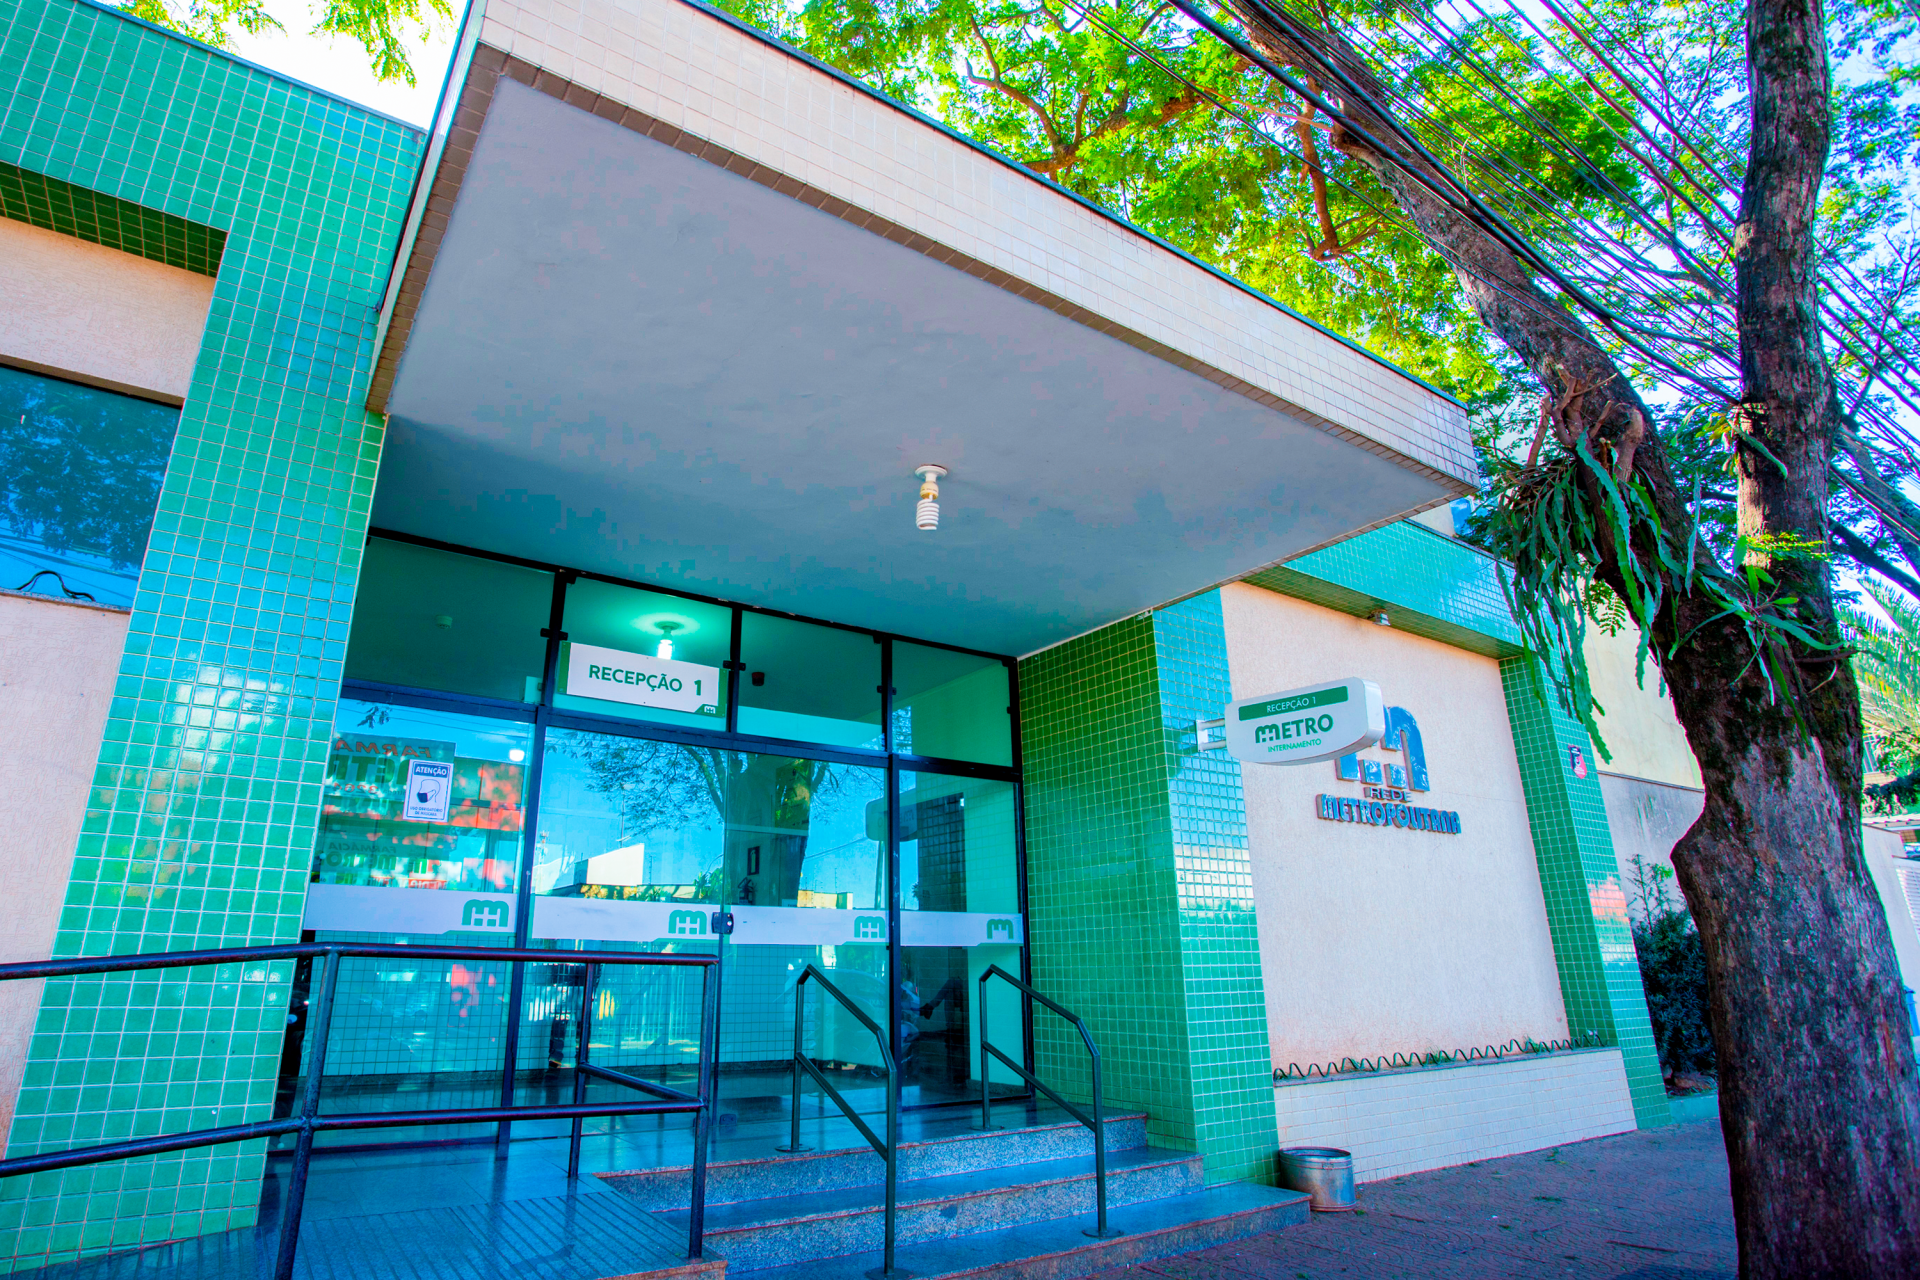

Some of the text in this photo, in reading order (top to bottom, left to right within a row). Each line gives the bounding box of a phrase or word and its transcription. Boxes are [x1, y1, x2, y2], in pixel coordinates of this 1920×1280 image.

[589, 664, 702, 696] RECEPÇÃO 1
[1266, 696, 1316, 713] RECEPÇÃO 1
[1255, 713, 1334, 743] METRO
[1267, 738, 1322, 753] INTERNAMENTO
[415, 766, 447, 776] ATENÇÃO
[1365, 787, 1413, 803] REDE
[1317, 794, 1461, 835] METROPOLITANA
